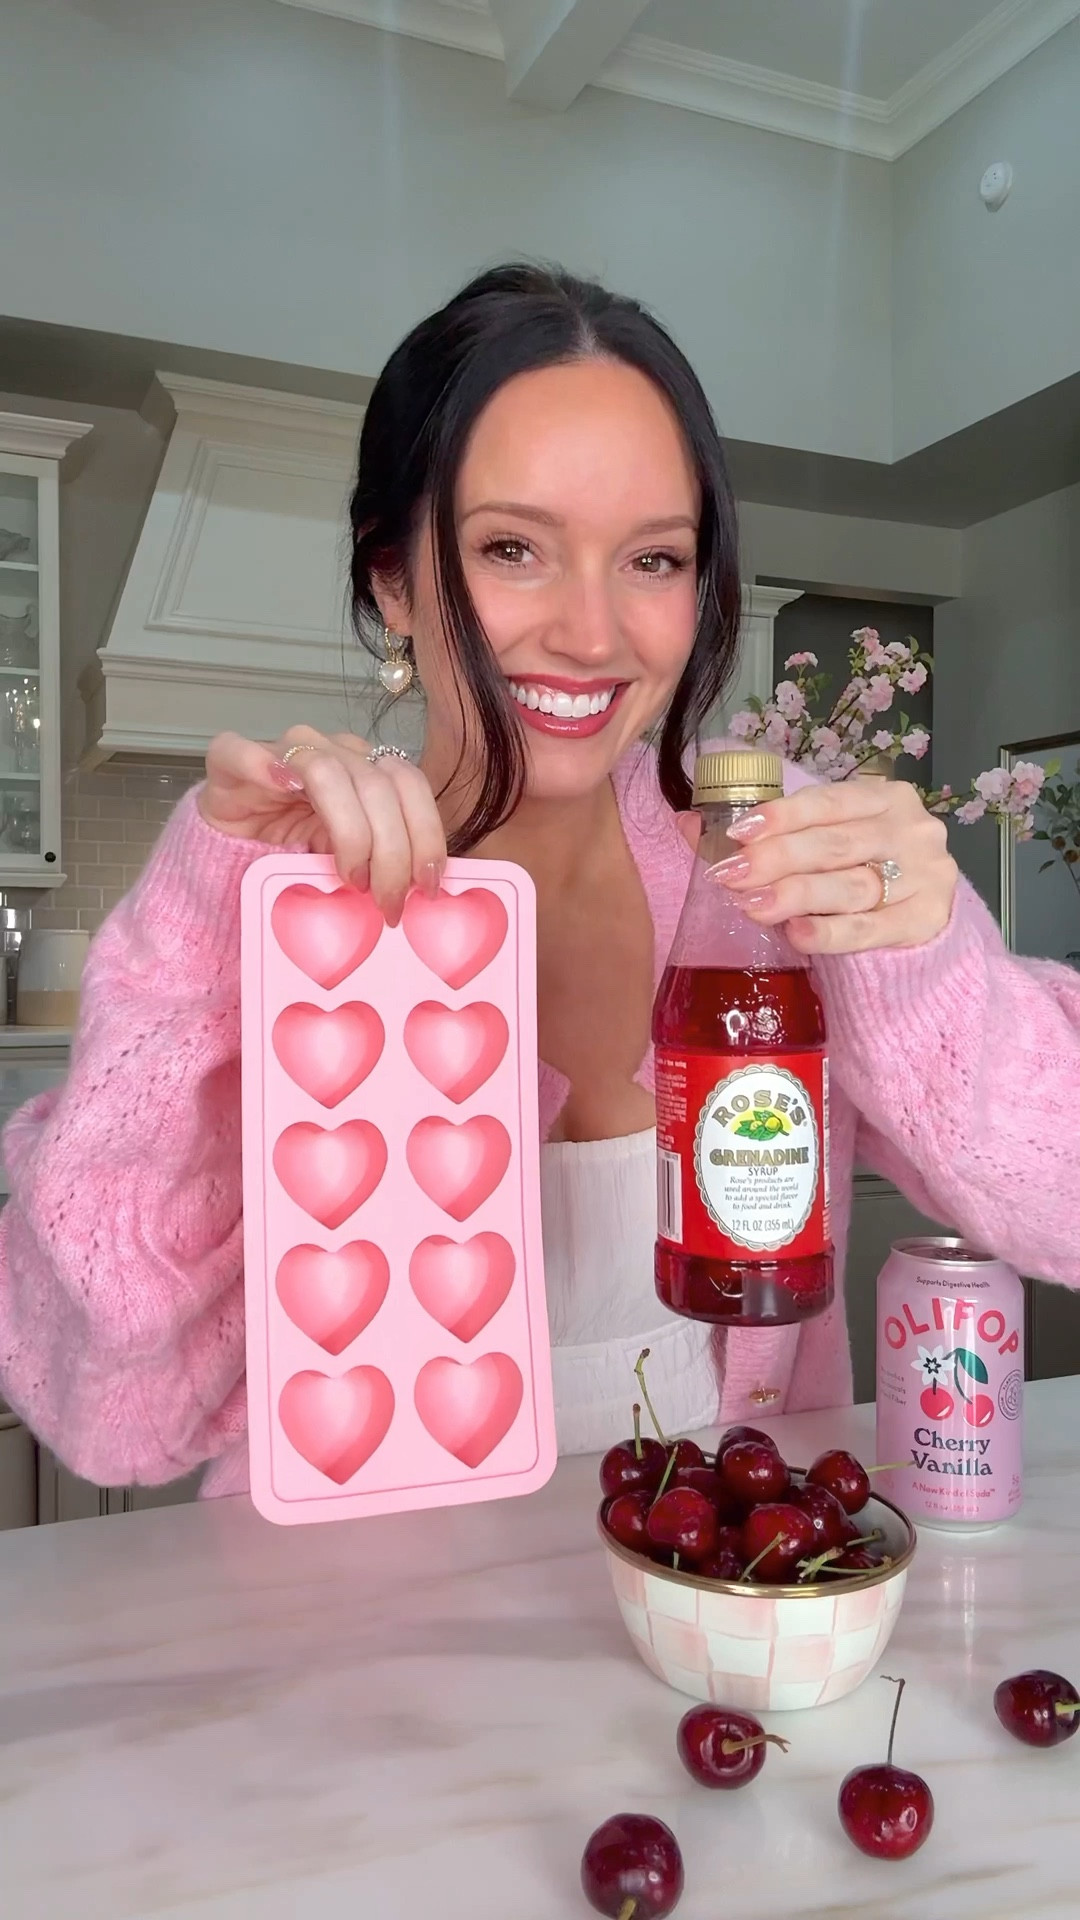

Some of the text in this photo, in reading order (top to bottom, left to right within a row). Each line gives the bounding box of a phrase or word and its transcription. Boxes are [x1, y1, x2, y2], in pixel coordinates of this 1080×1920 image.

[712, 1090, 806, 1128] ROSE'S
[709, 1146, 809, 1166] GRENADINE
[748, 1167, 778, 1176] SYRUP
[730, 1176, 752, 1184] Rose's
[754, 1176, 783, 1186] products
[769, 1184, 779, 1192] the
[781, 1183, 799, 1191] world
[755, 1193, 779, 1202] special
[780, 1193, 799, 1201] flavor
[741, 1203, 757, 1212] food
[758, 1202, 772, 1210] and
[732, 1219, 794, 1231] 12 FL OZ (355 mL)
[916, 1276, 942, 1287] Supports
[942, 1280, 971, 1289] Digestive
[884, 1298, 1019, 1355] OLIPOP
[914, 1427, 990, 1455] Cherry
[910, 1449, 993, 1476] Vanilla
[912, 1482, 918, 1490] A
[919, 1484, 938, 1494] New
